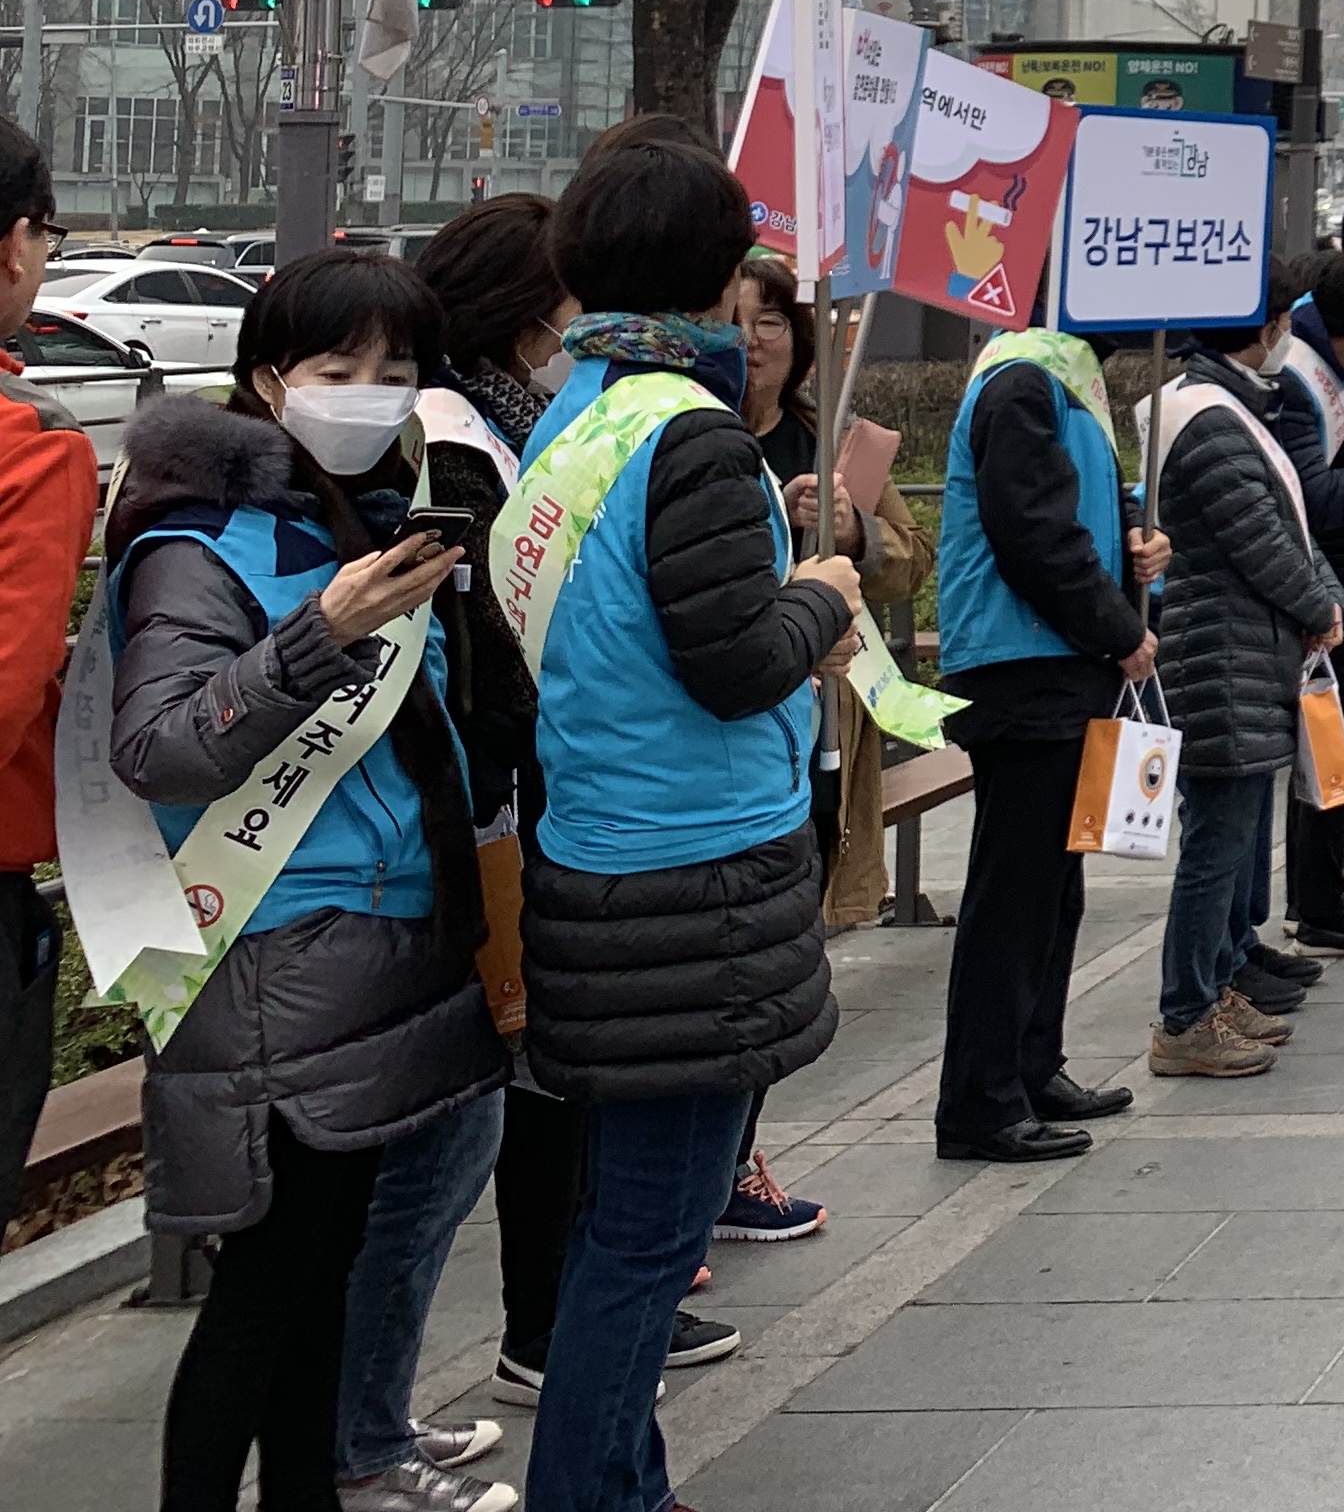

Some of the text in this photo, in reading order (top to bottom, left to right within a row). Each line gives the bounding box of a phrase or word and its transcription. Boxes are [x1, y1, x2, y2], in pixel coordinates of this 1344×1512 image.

[1083, 60, 1106, 73] NO!
[1175, 61, 1199, 74] NO!
[922, 87, 987, 131] 역에서만
[1184, 143, 1210, 178] 강남
[770, 212, 797, 234] 강남
[1083, 216, 1252, 266] 강남구보건소
[223, 718, 345, 852] 주세요
